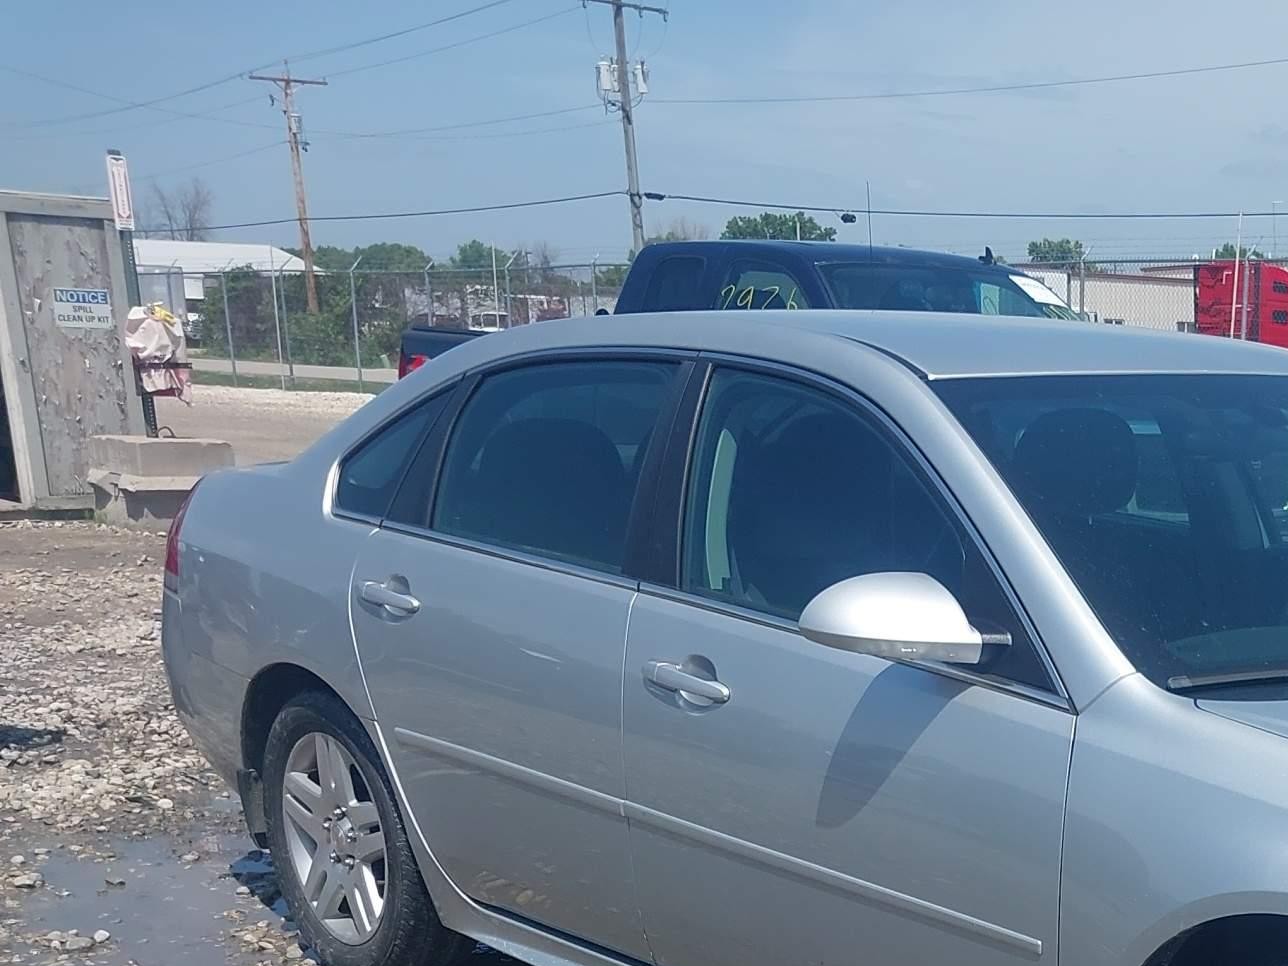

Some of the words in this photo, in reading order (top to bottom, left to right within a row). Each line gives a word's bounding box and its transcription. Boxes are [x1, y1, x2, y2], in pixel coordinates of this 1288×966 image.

[56, 290, 106, 304] NOTICE
[72, 305, 94, 313] SPILL
[58, 314, 83, 322] CLEAN
[85, 315, 96, 323] UP
